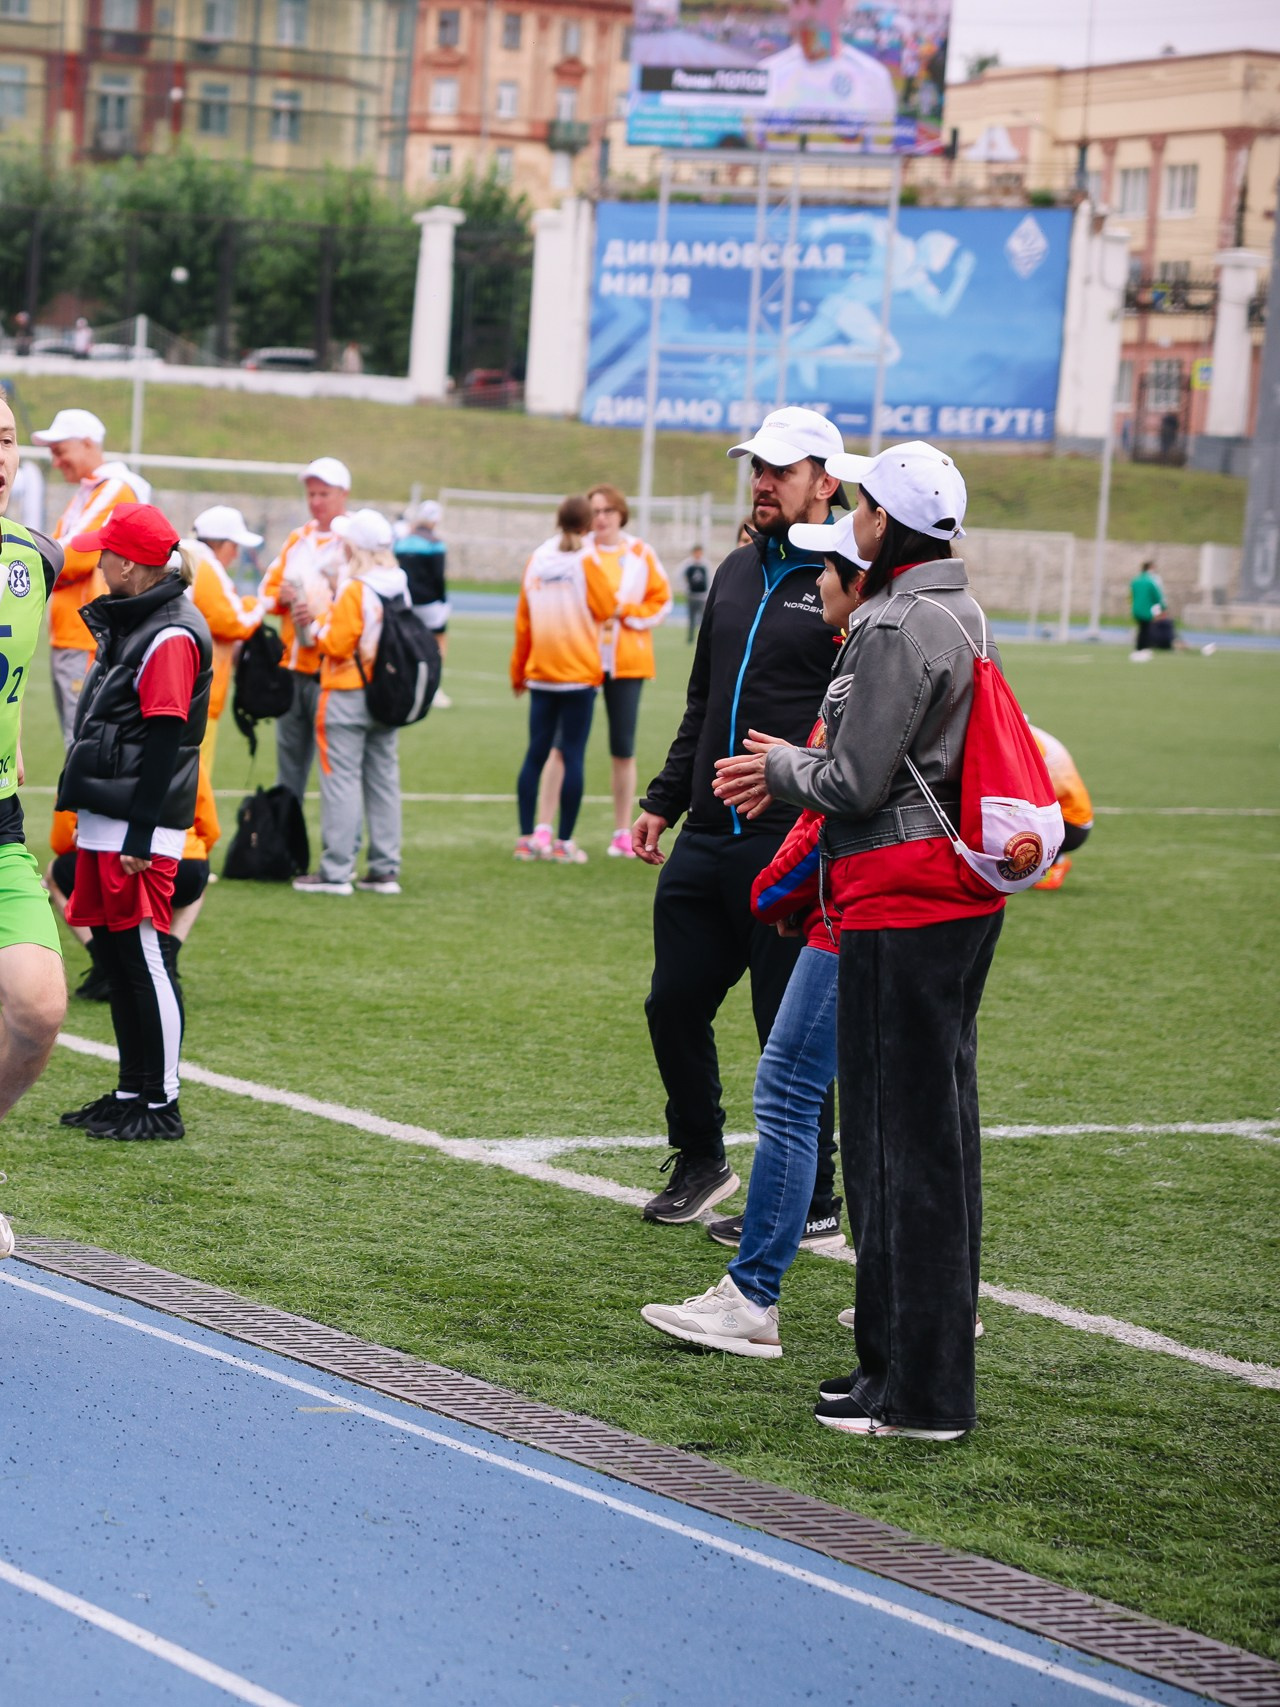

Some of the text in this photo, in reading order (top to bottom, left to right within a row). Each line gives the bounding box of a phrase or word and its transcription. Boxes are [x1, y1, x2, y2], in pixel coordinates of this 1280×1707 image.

[602, 239, 846, 269] ДИНАМОВСКАЯ
[938, 406, 1045, 435] БЕГУТ!
[783, 601, 824, 614] NORDSK
[806, 1216, 838, 1233] HOKA
